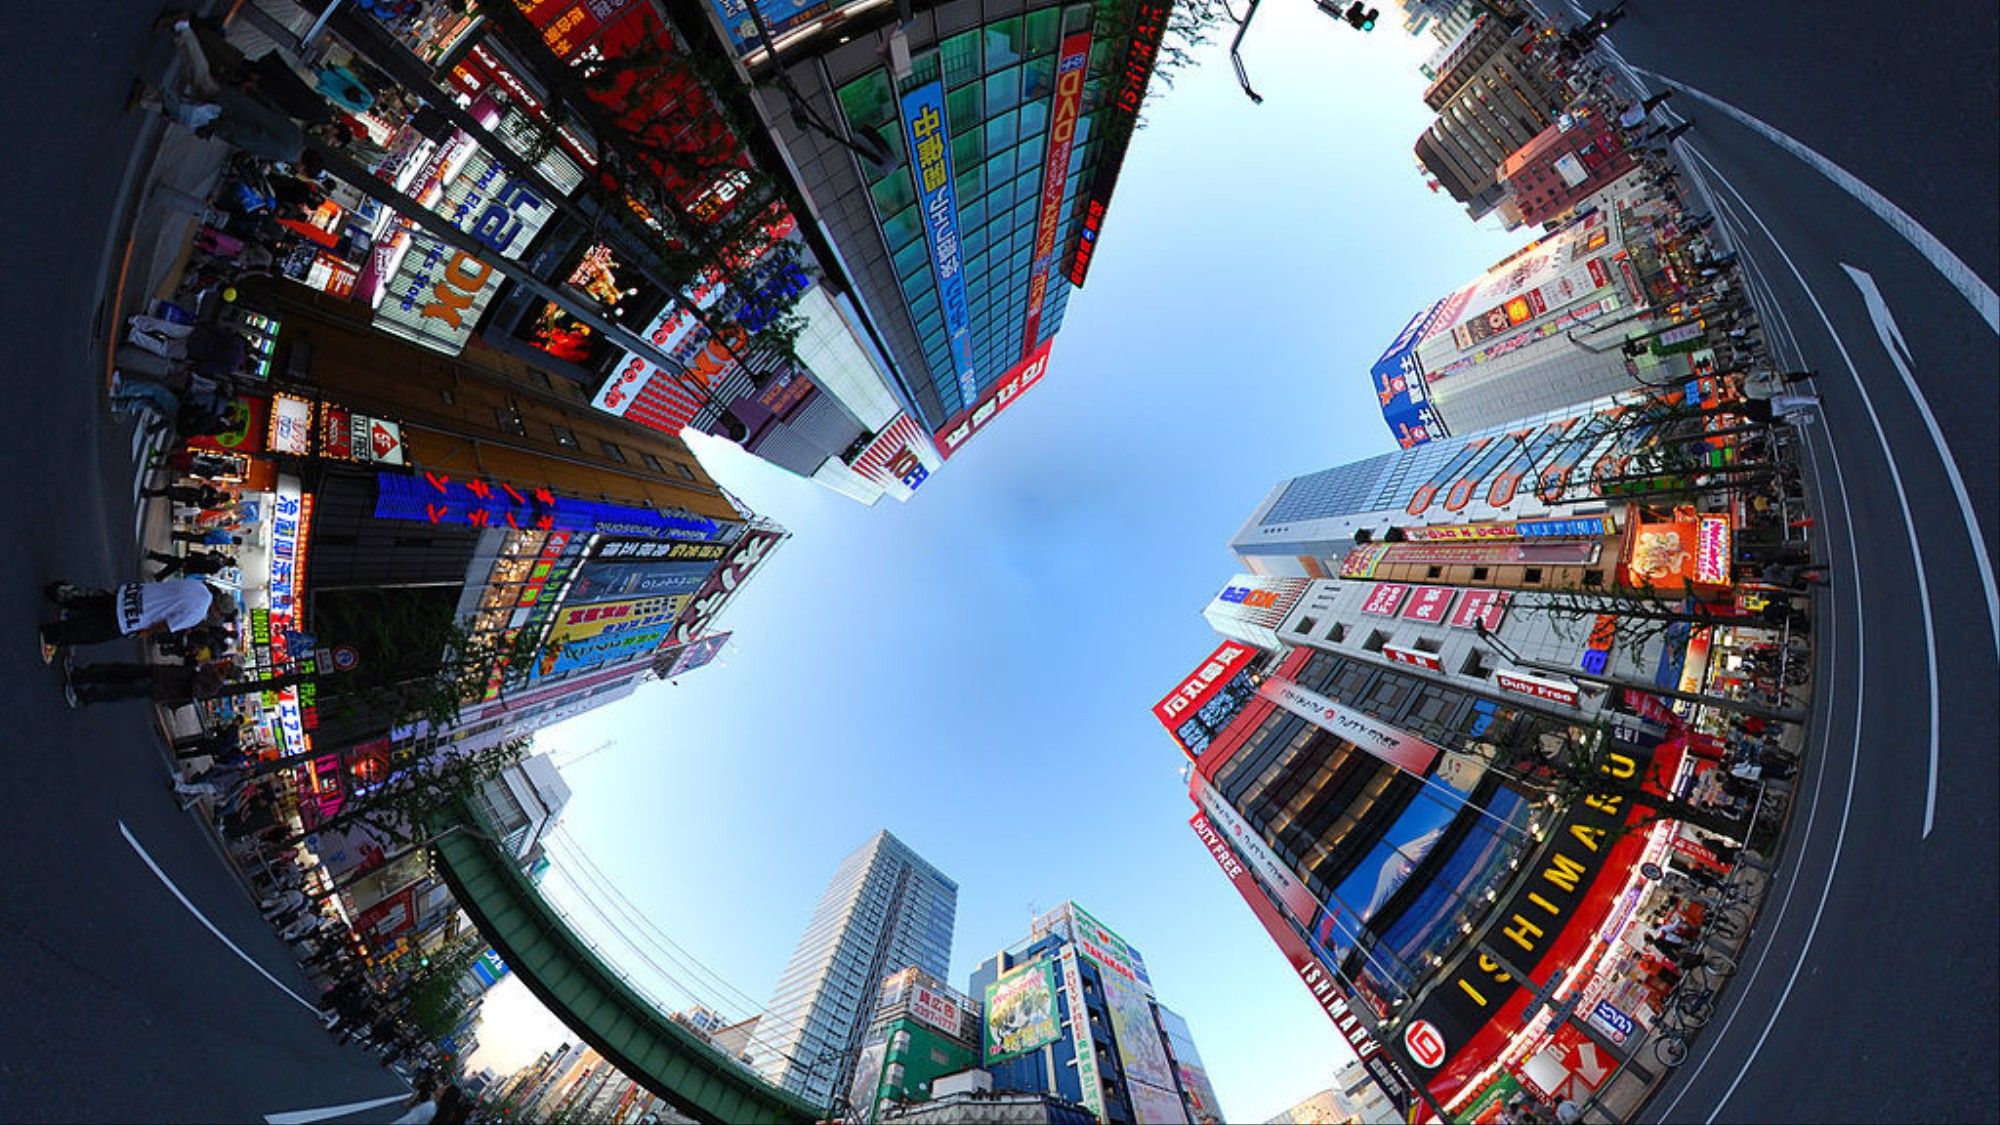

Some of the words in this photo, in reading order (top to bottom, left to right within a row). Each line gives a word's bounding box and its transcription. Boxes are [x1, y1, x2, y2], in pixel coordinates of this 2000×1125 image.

[1053, 70, 1079, 143] DVD
[478, 159, 505, 191] ome
[1500, 676, 1534, 695] Duty
[1536, 684, 1573, 703] Free
[1192, 816, 1219, 847] DUTY
[1212, 841, 1244, 880] FREE
[1299, 961, 1382, 1058] ISHIMARU
